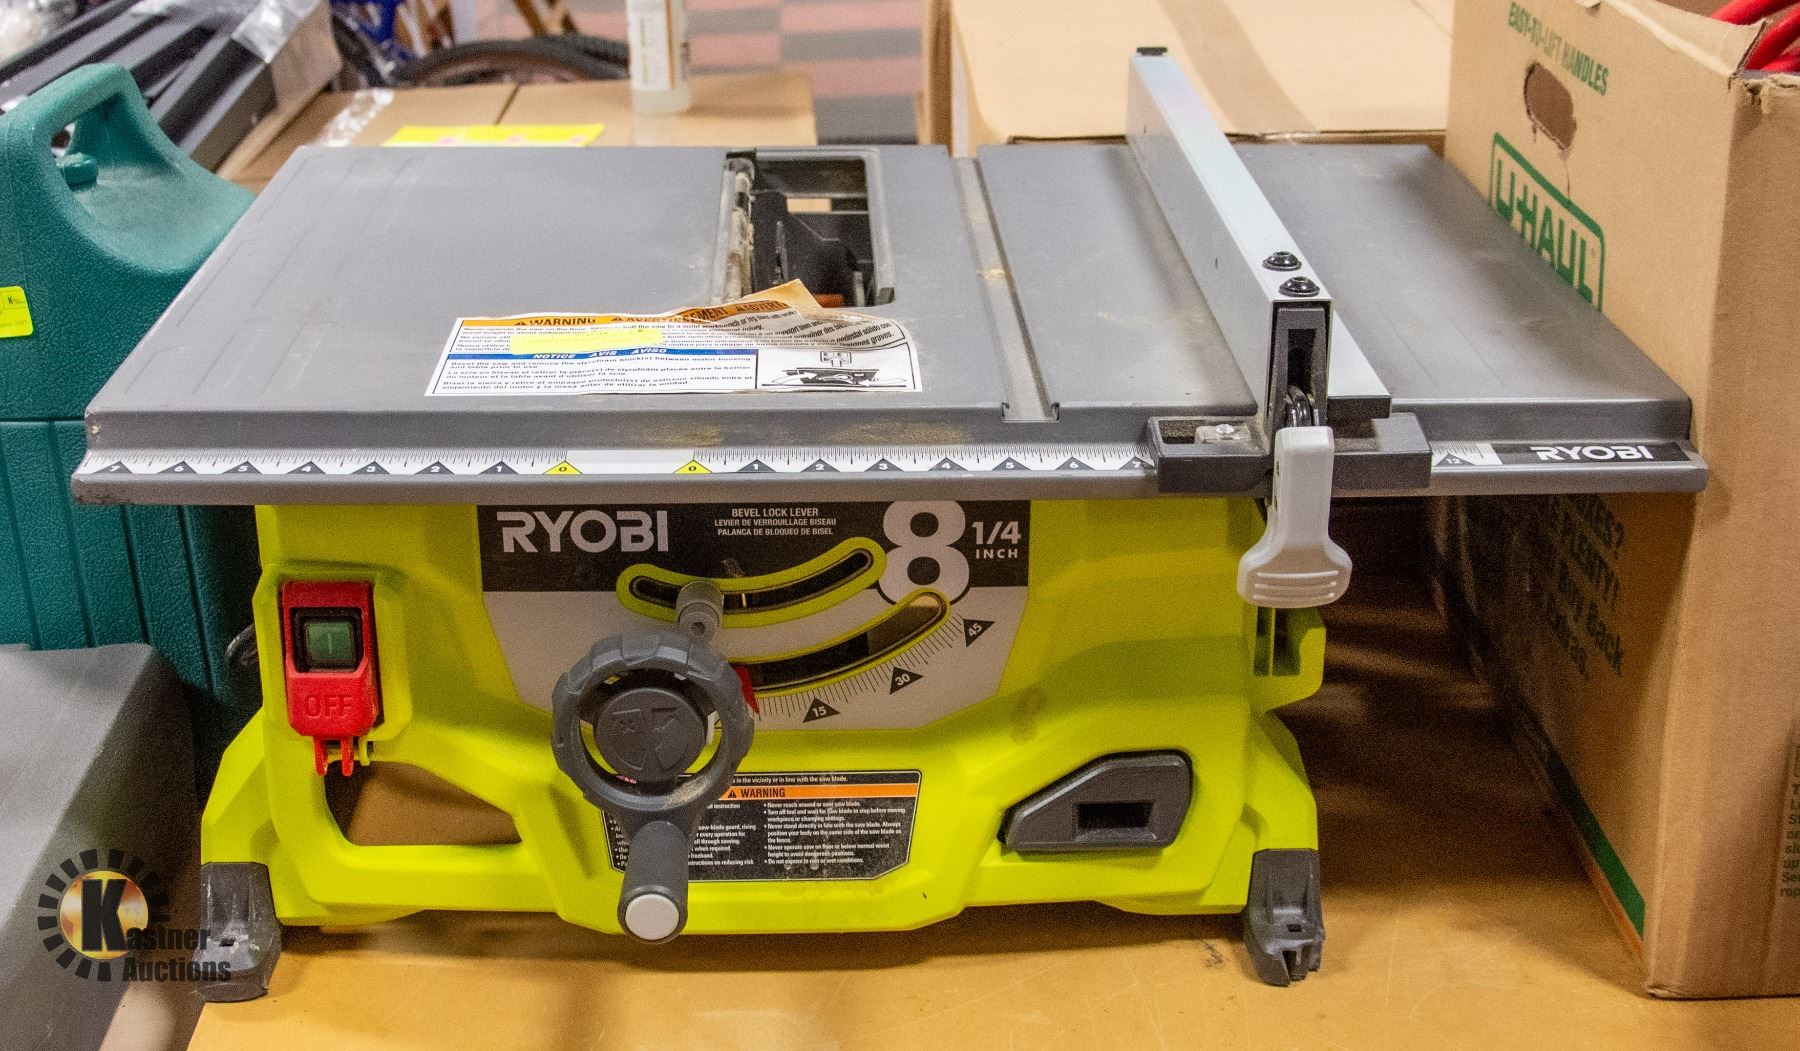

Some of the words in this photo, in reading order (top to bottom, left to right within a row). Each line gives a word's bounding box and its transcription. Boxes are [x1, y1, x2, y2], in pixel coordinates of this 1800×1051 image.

[1562, 42, 1609, 96] HANDLES
[529, 317, 596, 327] WARNING
[590, 350, 617, 358] AVIS
[1530, 445, 1655, 461] RYOBI
[1447, 457, 1462, 465] 12
[731, 508, 761, 518] BEVEL
[763, 508, 788, 517] LOCK
[789, 507, 819, 517] LEVER
[714, 519, 740, 527] LEVIER
[741, 519, 752, 527] DE
[753, 518, 808, 526] VERROUILLAGE
[809, 518, 837, 526] BISEAU
[497, 509, 668, 553] RYOBI
[717, 528, 752, 536] PALANCA
[812, 527, 834, 535] BISEL
[879, 500, 970, 605] 8
[971, 520, 1022, 545] 1/4
[976, 548, 1018, 559] INCH
[968, 622, 983, 638] 45
[895, 673, 911, 685] 30
[305, 694, 352, 720] OFF
[812, 705, 827, 717] 15
[741, 788, 786, 798] WARNING
[838, 808, 853, 816] blade
[887, 807, 905, 815] moving
[701, 838, 720, 846] through
[744, 859, 754, 867] risk
